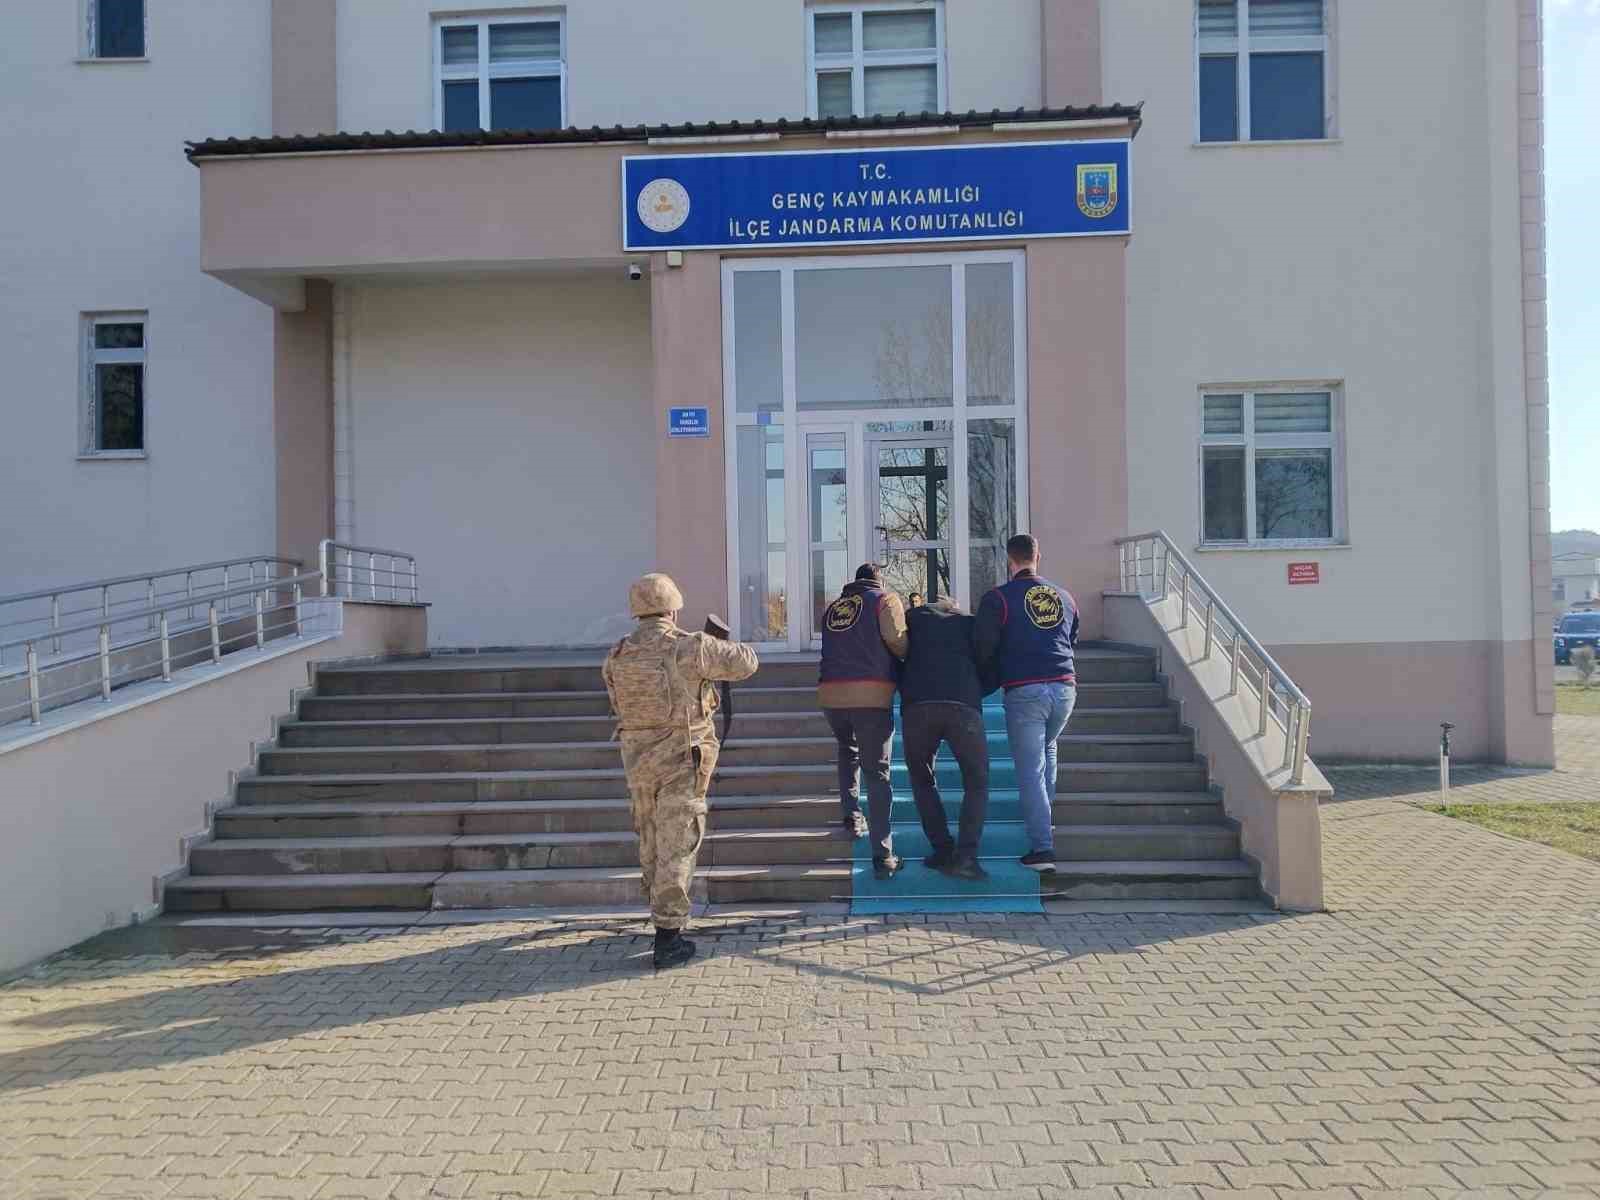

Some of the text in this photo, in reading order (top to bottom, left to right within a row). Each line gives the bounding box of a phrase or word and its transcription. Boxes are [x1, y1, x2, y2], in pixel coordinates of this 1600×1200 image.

[860, 163, 892, 180] T.C.
[772, 185, 980, 211] GENÇ KAYMAKAMLIĞI
[729, 209, 1024, 240] İLÇE JANDARMA KOMUTANLIĞI
